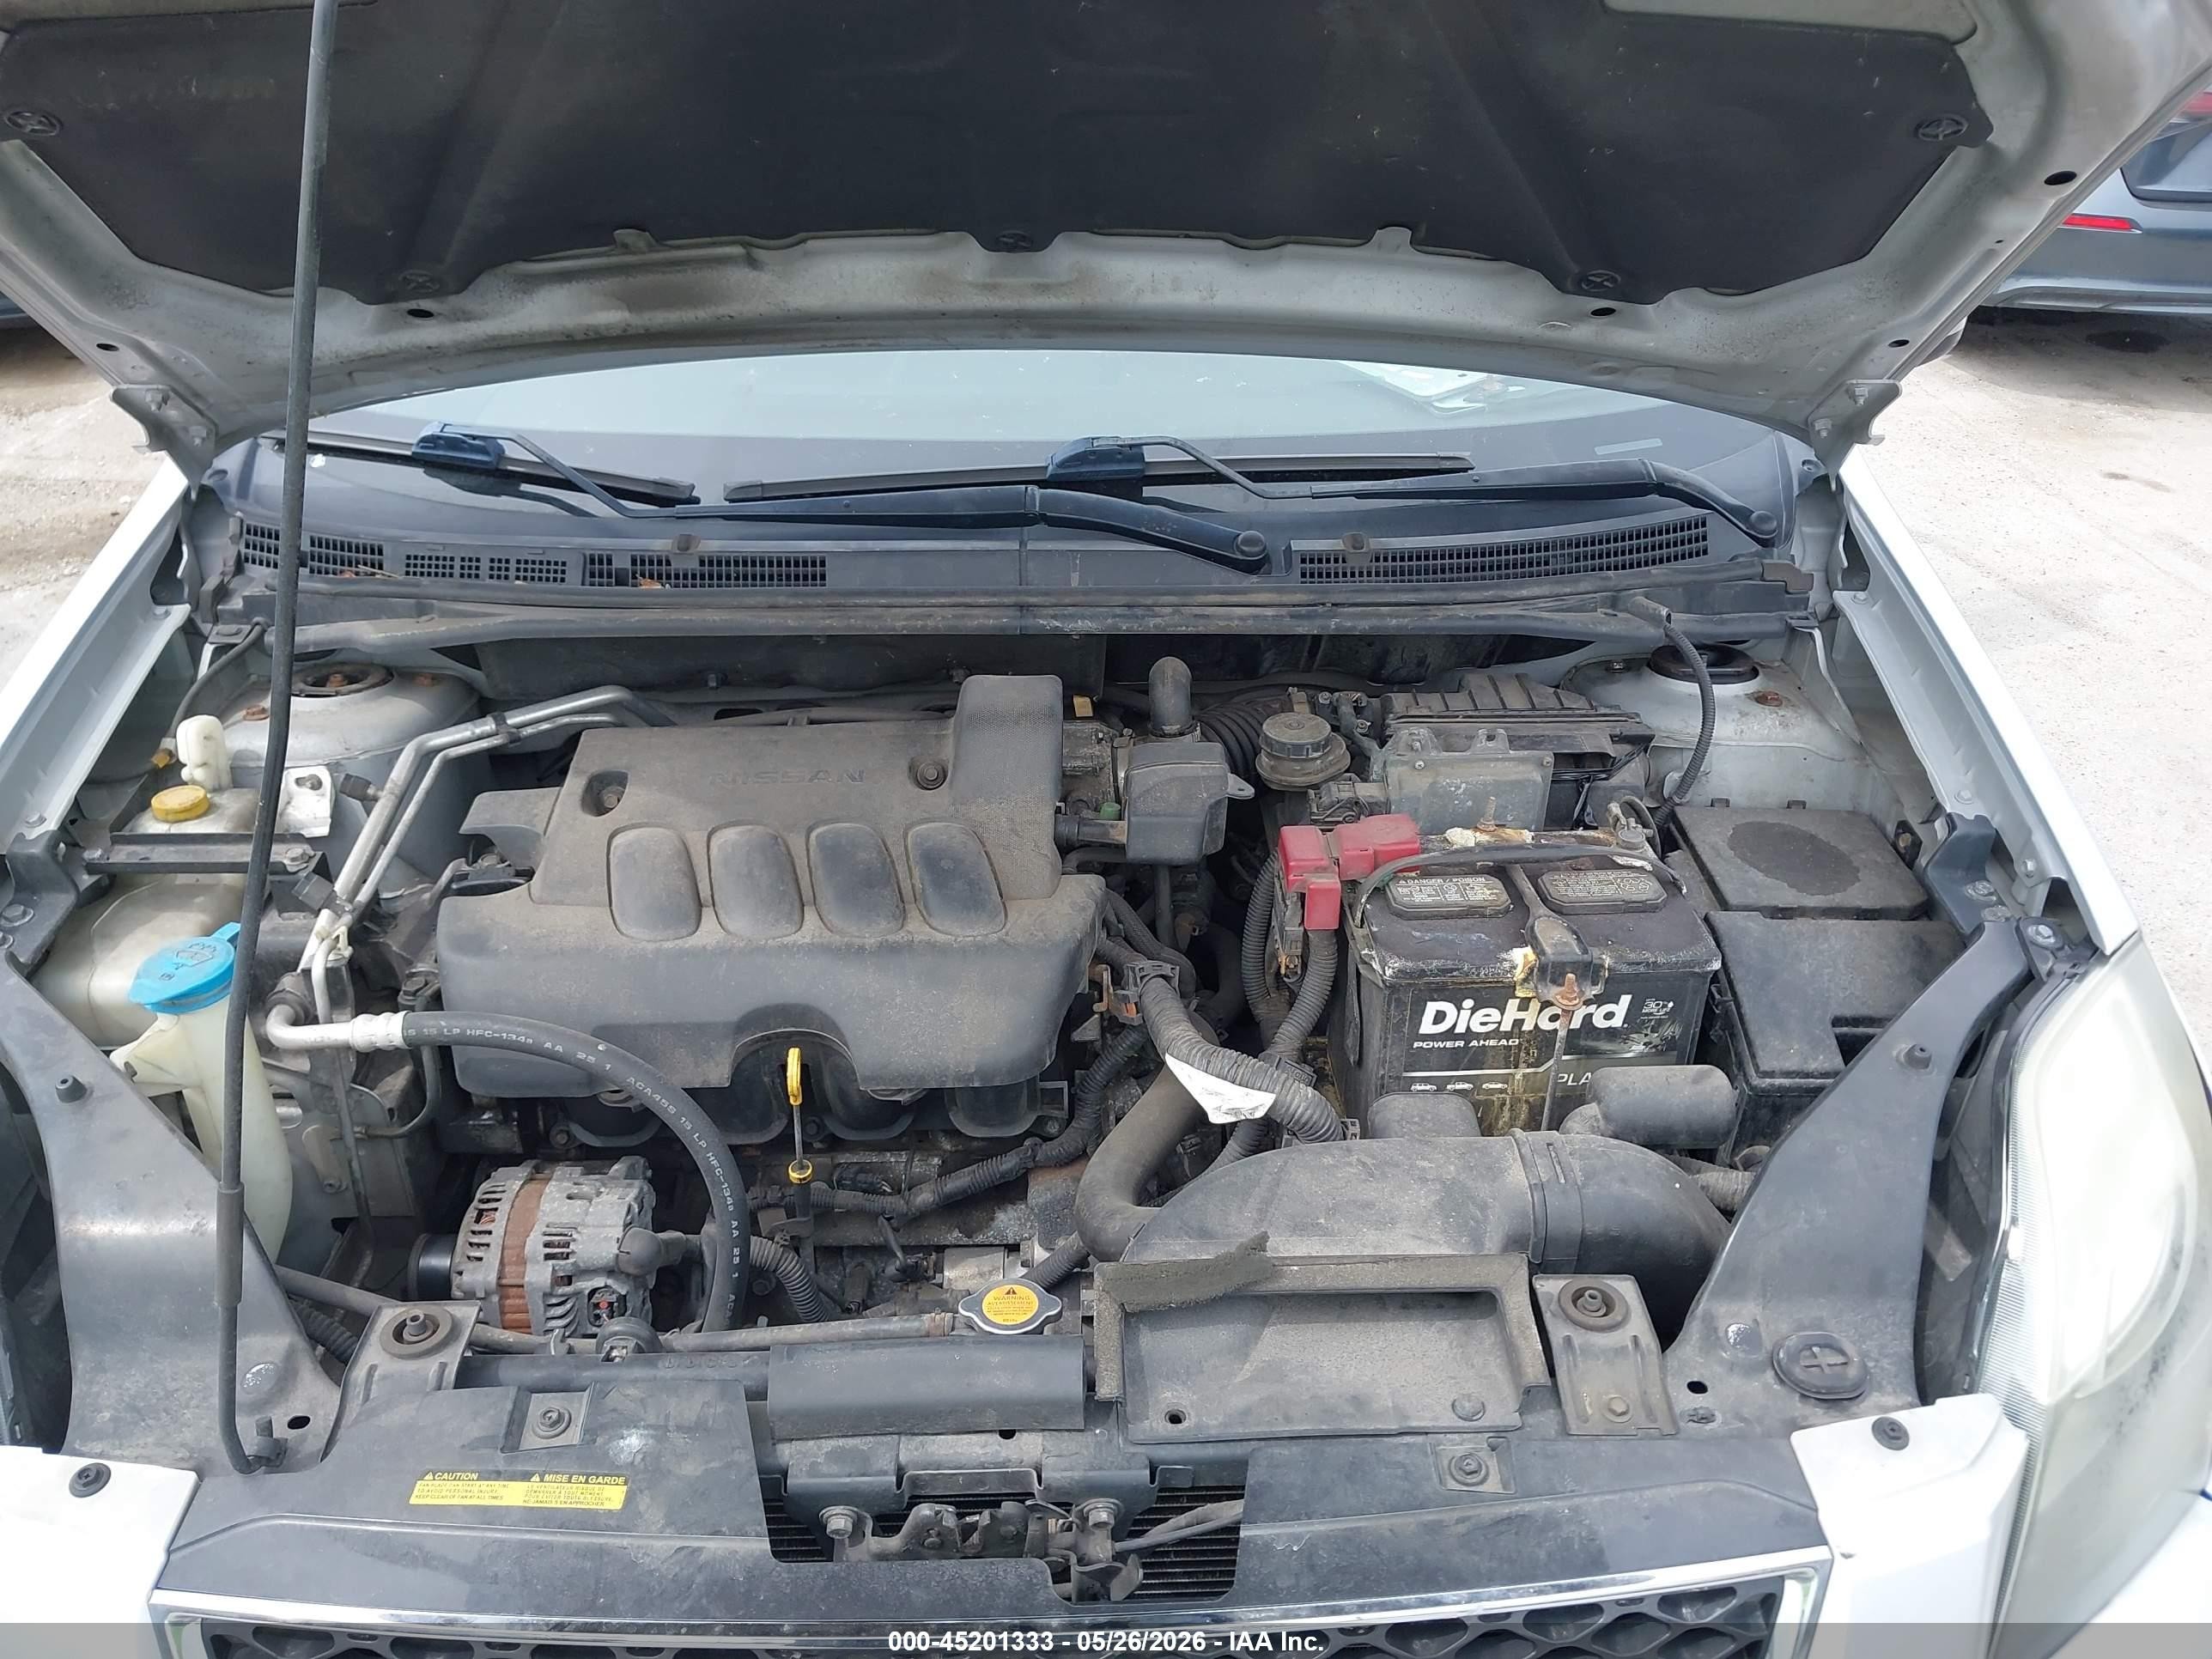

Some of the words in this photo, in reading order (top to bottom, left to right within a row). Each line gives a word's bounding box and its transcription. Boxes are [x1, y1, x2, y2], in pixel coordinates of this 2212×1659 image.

[709, 769, 866, 785] NISSAN
[1419, 994, 1632, 1035] DieHard
[466, 1029, 533, 1044] HFC-134a
[544, 1042, 563, 1053] AA
[576, 1051, 596, 1063] 25
[1468, 1038, 1519, 1047] AHEAD
[693, 1133, 708, 1148] LP
[706, 1152, 734, 1212] HFC-134a
[731, 1220, 739, 1237] AA
[732, 1247, 740, 1264] 25
[434, 1472, 478, 1480] CAUTION
[543, 1474, 568, 1483] MISE
[571, 1474, 586, 1483] EN
[588, 1475, 625, 1485] GARDE
